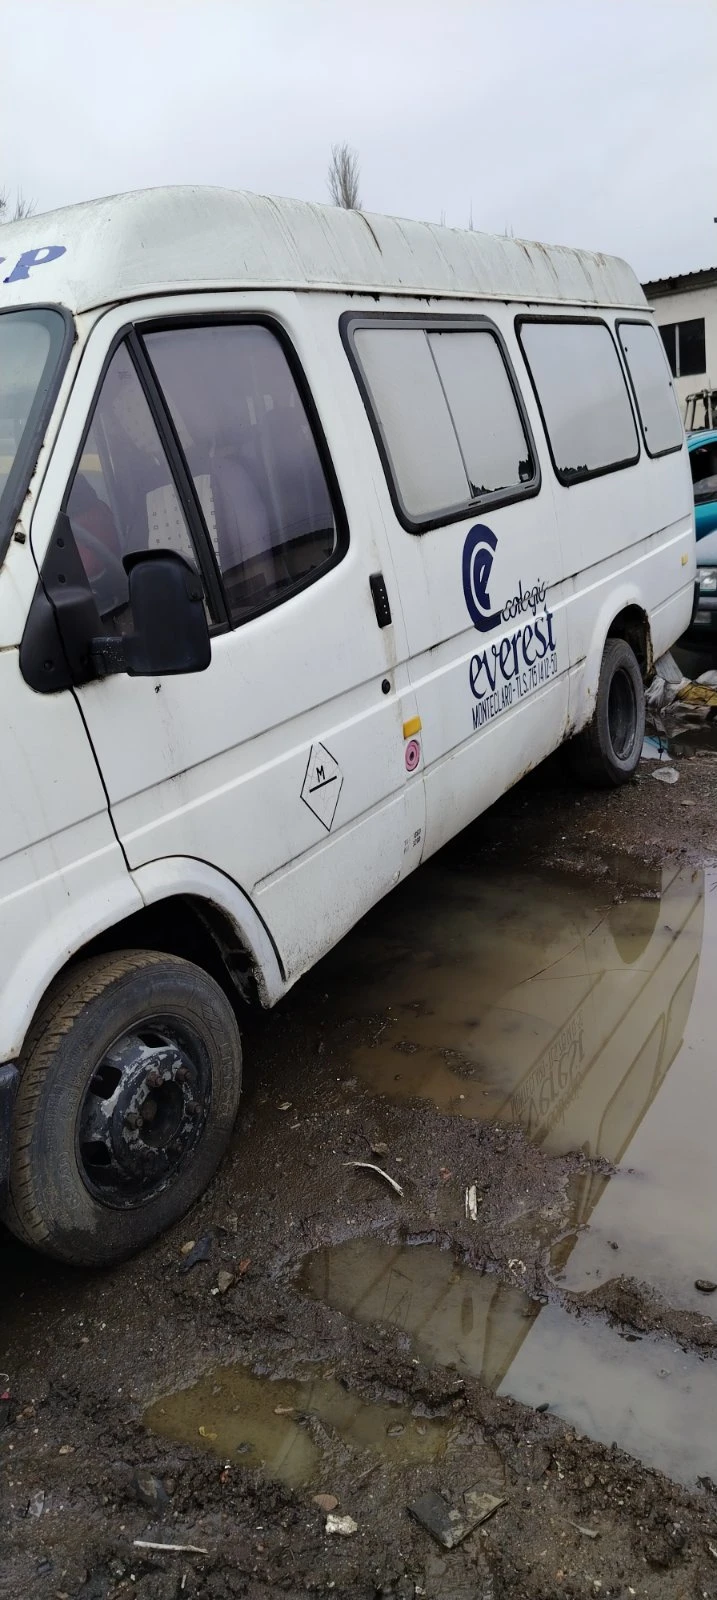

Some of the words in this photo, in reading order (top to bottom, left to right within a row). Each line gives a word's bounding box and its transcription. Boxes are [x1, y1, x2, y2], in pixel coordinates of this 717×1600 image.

[501, 577, 548, 622] colegio
[469, 602, 556, 699] everest
[316, 764, 326, 783] M
